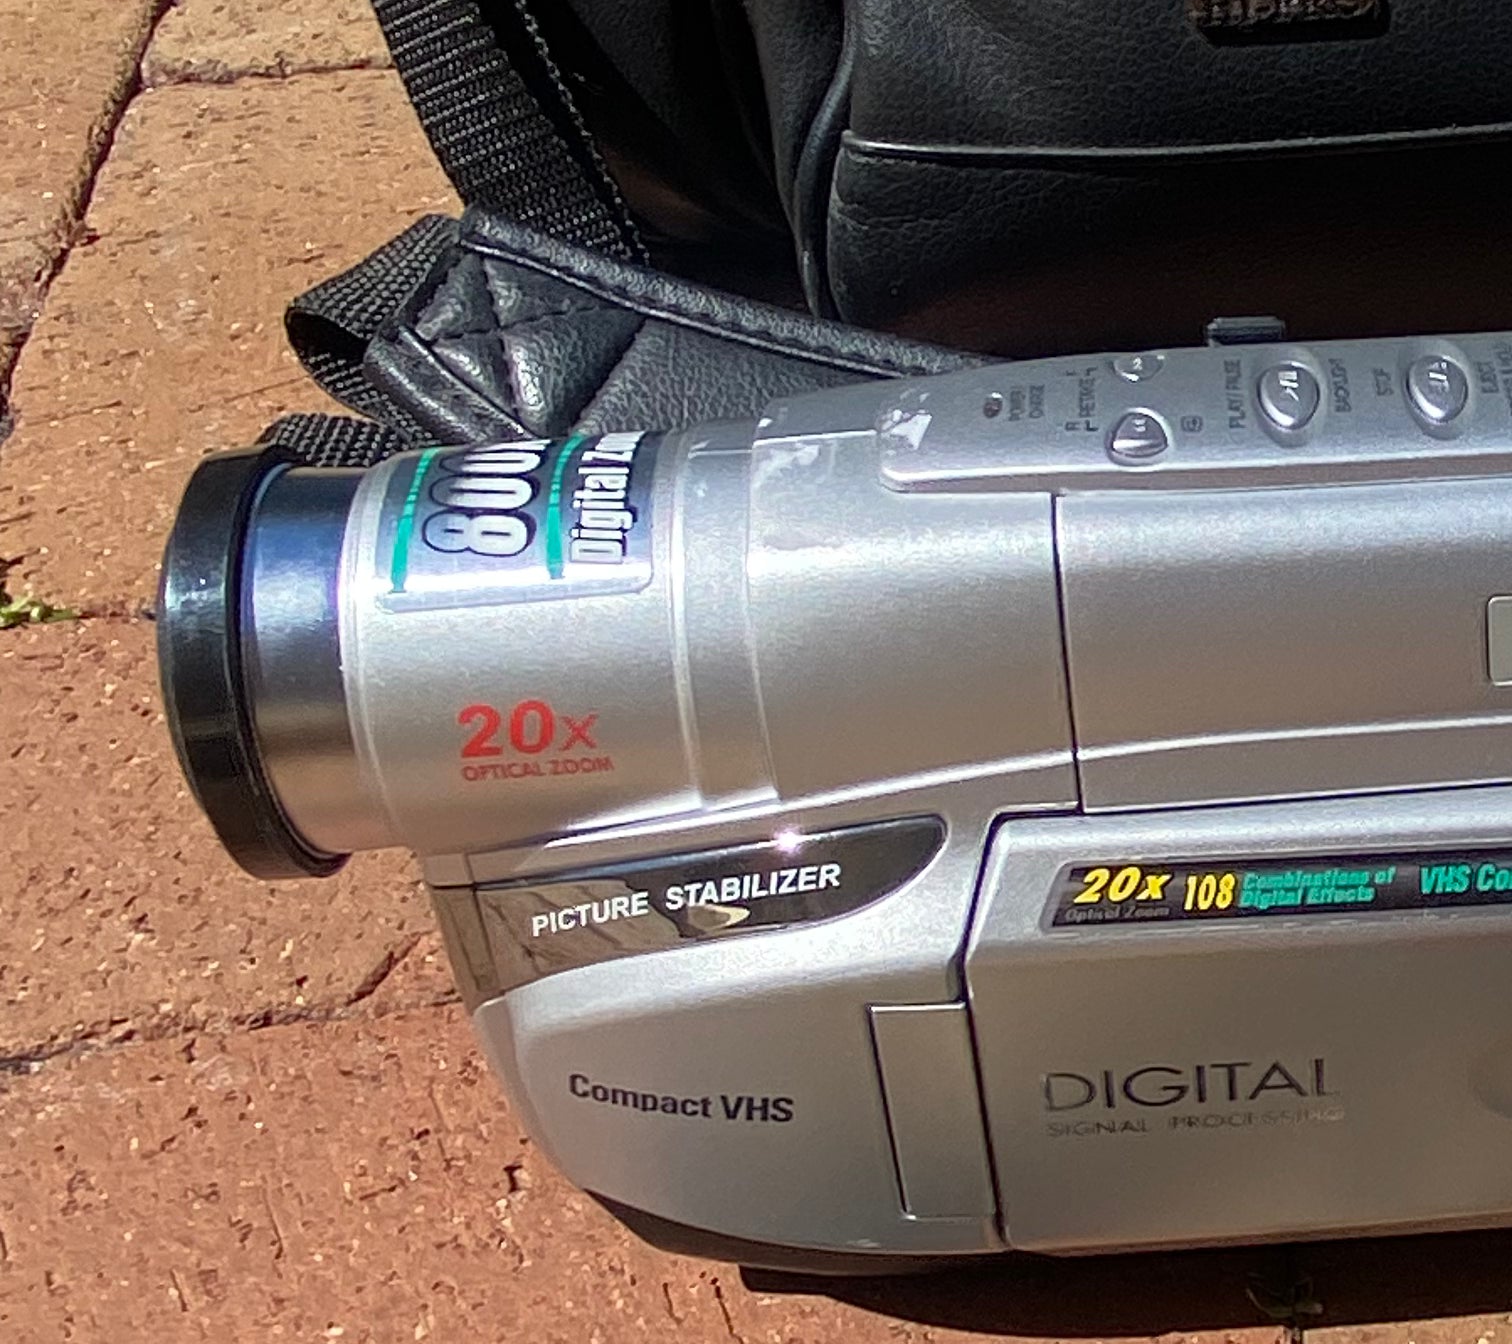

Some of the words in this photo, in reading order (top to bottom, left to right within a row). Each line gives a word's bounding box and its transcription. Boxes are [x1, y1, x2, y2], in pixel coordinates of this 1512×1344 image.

[461, 760, 547, 782] OPTICAL
[547, 756, 615, 776] ZOOM
[1073, 866, 1172, 904] 20x
[1184, 873, 1236, 911] 108
[1374, 866, 1396, 885] of
[1420, 864, 1472, 895] VHS
[532, 891, 649, 937] PICTURE
[665, 863, 842, 911] STABILIZER
[1240, 887, 1303, 910] Digital
[1306, 885, 1377, 906] Effects
[568, 1072, 713, 1118] Compact
[720, 1094, 796, 1124] VHS
[1045, 1058, 1340, 1110] DIGITAL
[1049, 1118, 1149, 1137] SIGNAL
